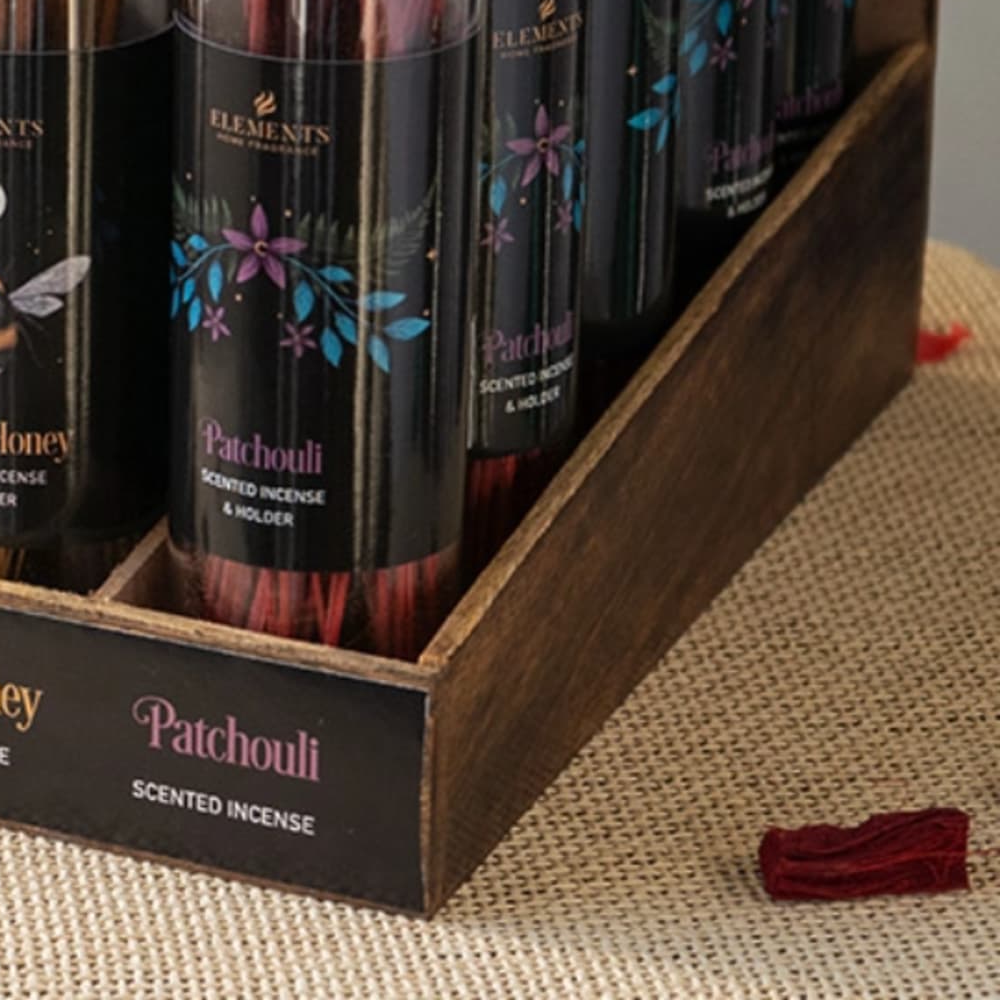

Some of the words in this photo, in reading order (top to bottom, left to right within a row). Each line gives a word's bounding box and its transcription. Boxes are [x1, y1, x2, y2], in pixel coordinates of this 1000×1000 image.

[209, 107, 332, 143] ELEMENTS
[480, 371, 536, 394] SCENTED
[200, 417, 322, 474] Patchouli
[200, 467, 258, 498] SCENTED
[260, 485, 327, 506] INCENSE
[222, 501, 233, 516] &
[235, 504, 294, 527] HOLDER
[132, 695, 321, 782] Patchouli
[132, 779, 222, 816] SCENTED
[226, 799, 316, 836] INCENSE
